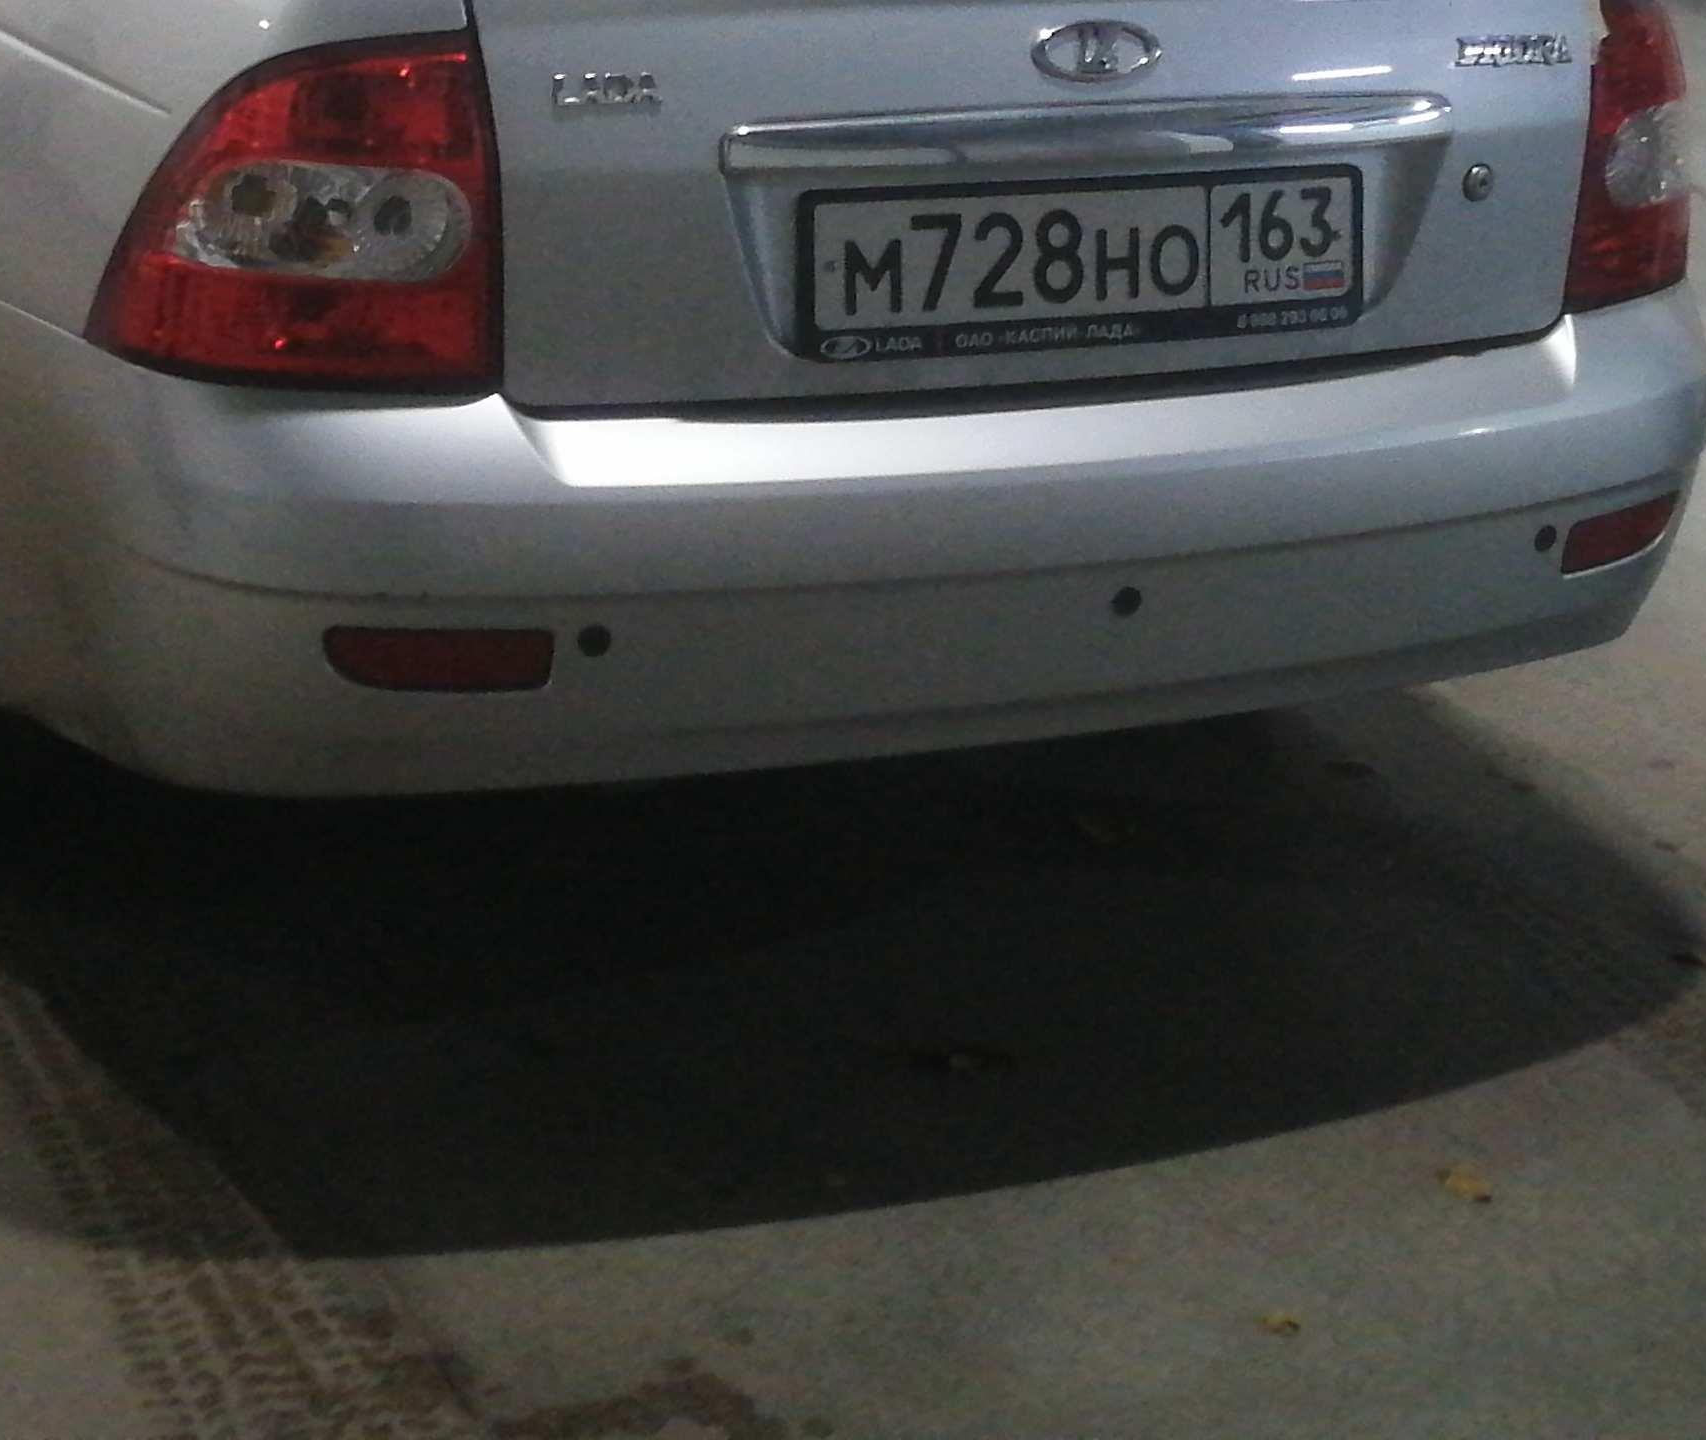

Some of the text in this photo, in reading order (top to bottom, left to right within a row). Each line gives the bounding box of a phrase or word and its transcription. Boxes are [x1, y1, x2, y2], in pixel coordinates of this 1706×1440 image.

[552, 71, 662, 106] LADA
[1219, 185, 1334, 265] 163
[1244, 266, 1300, 293] RUS
[875, 335, 923, 353] LADA
